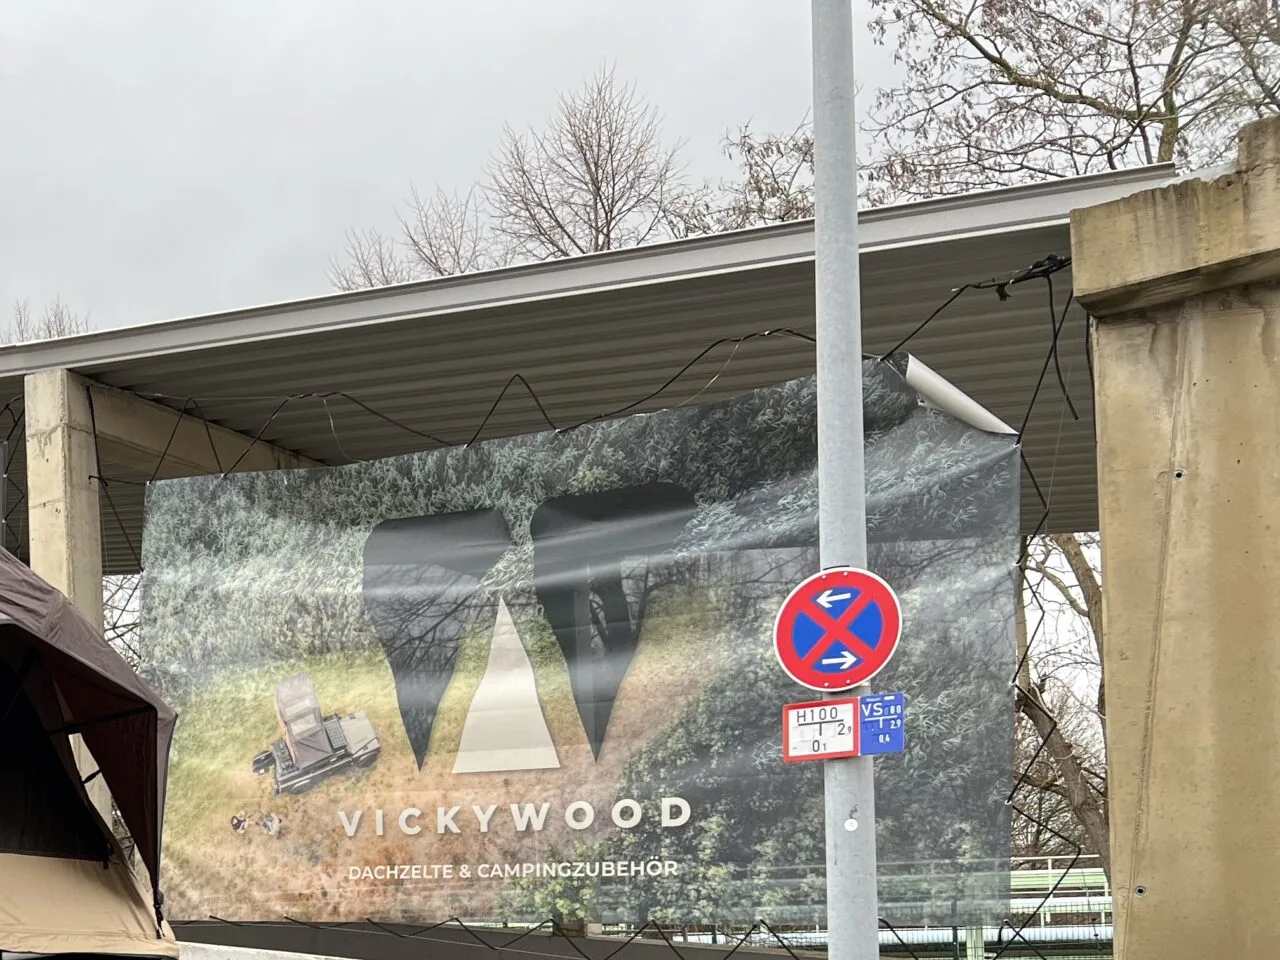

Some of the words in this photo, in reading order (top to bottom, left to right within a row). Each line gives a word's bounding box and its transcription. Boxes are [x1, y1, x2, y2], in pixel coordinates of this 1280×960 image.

[796, 706, 838, 723] H100
[861, 702, 883, 717] VS
[337, 796, 692, 837] VICKYWOOD
[348, 863, 453, 881] DACHZELTE
[459, 863, 471, 878] &
[477, 856, 679, 879] CAMPINGZUBEHÖR
